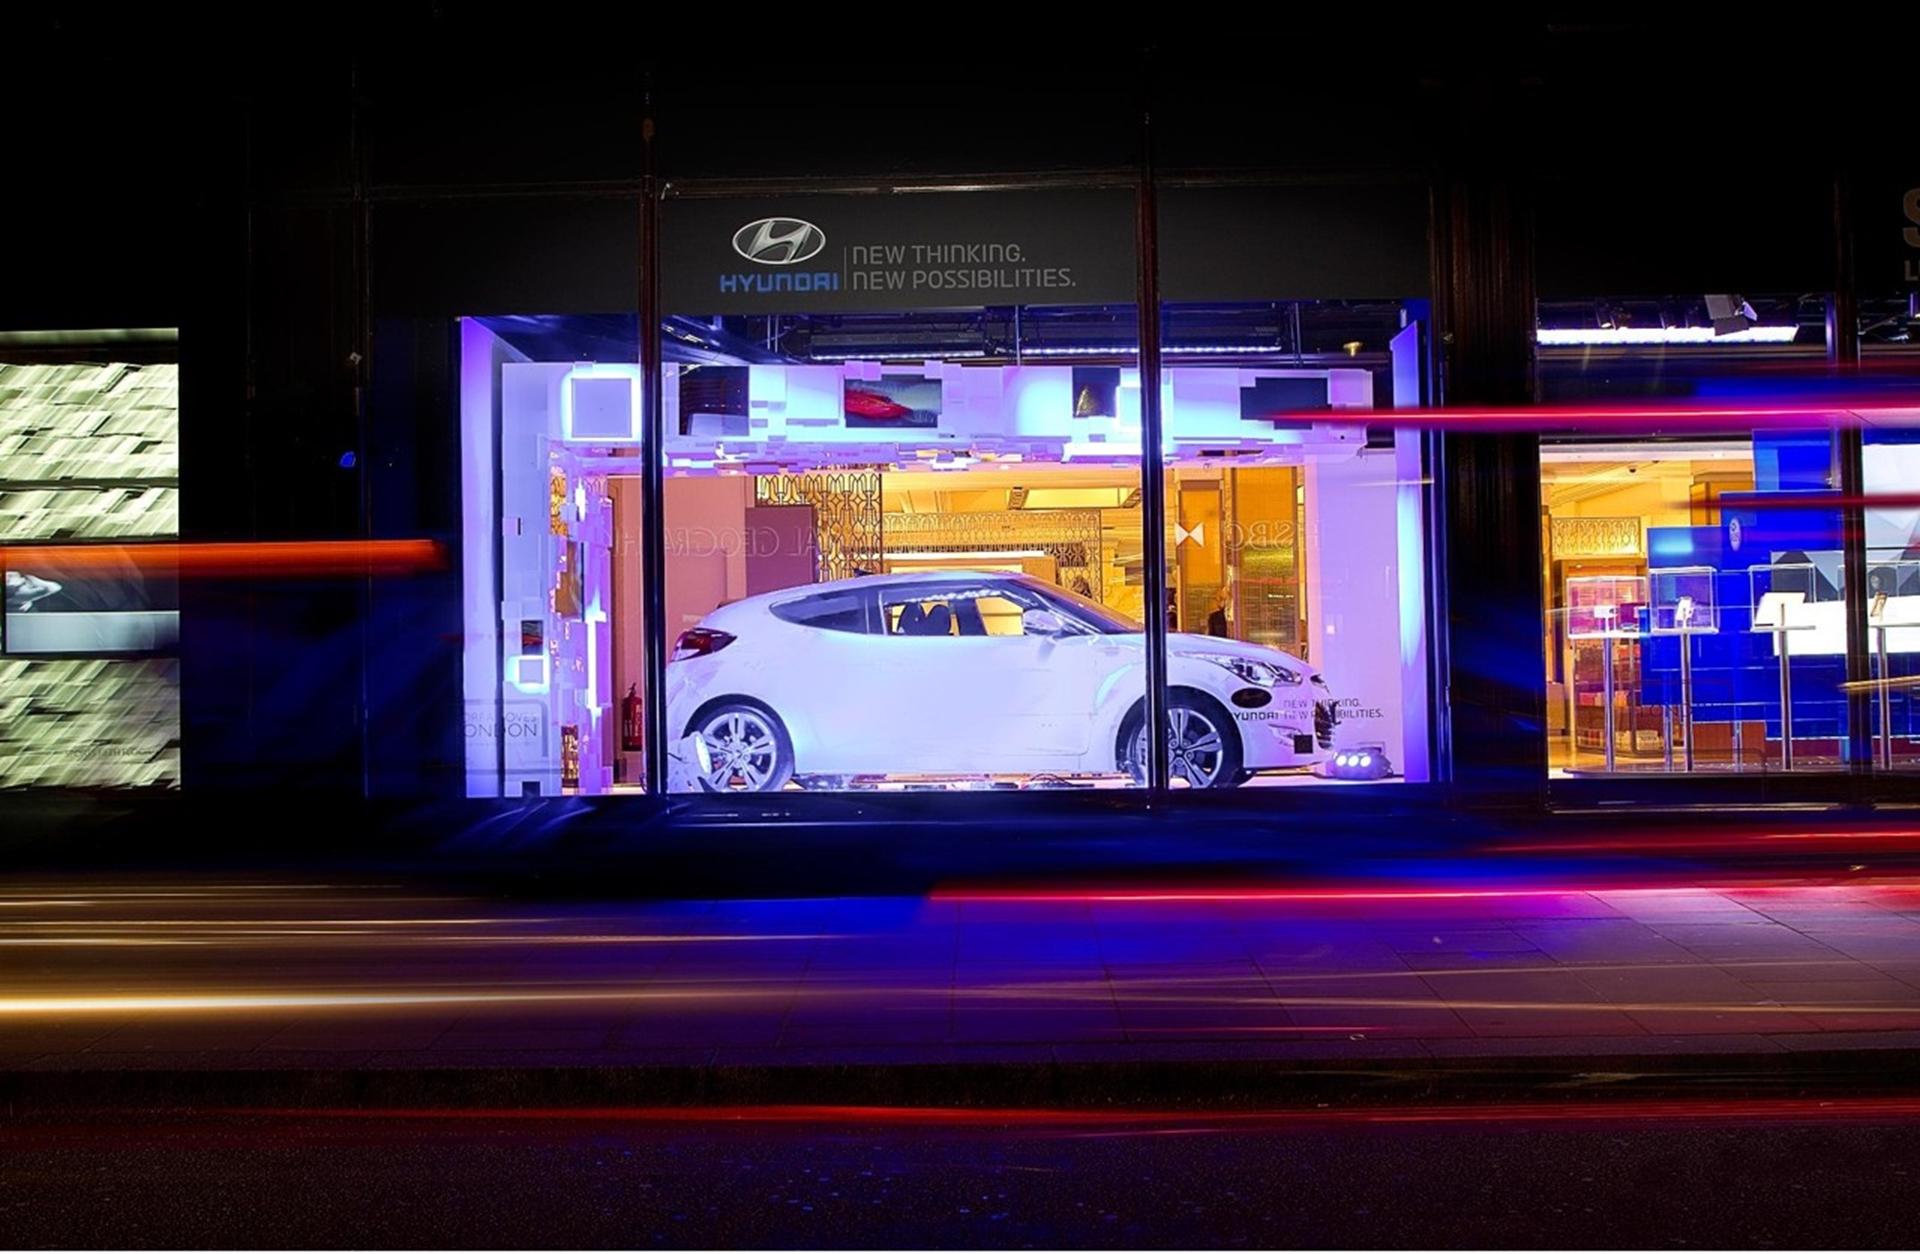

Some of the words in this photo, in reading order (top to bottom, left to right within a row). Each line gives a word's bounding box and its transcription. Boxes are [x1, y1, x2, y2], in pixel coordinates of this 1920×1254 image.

[852, 245, 906, 265] NEW
[911, 243, 1026, 264] THINKING.
[720, 272, 839, 293] HYUNDAI
[852, 270, 906, 290] NEW
[912, 267, 1077, 289] POSSIBILITIES.
[1233, 711, 1279, 721] YUNDAI
